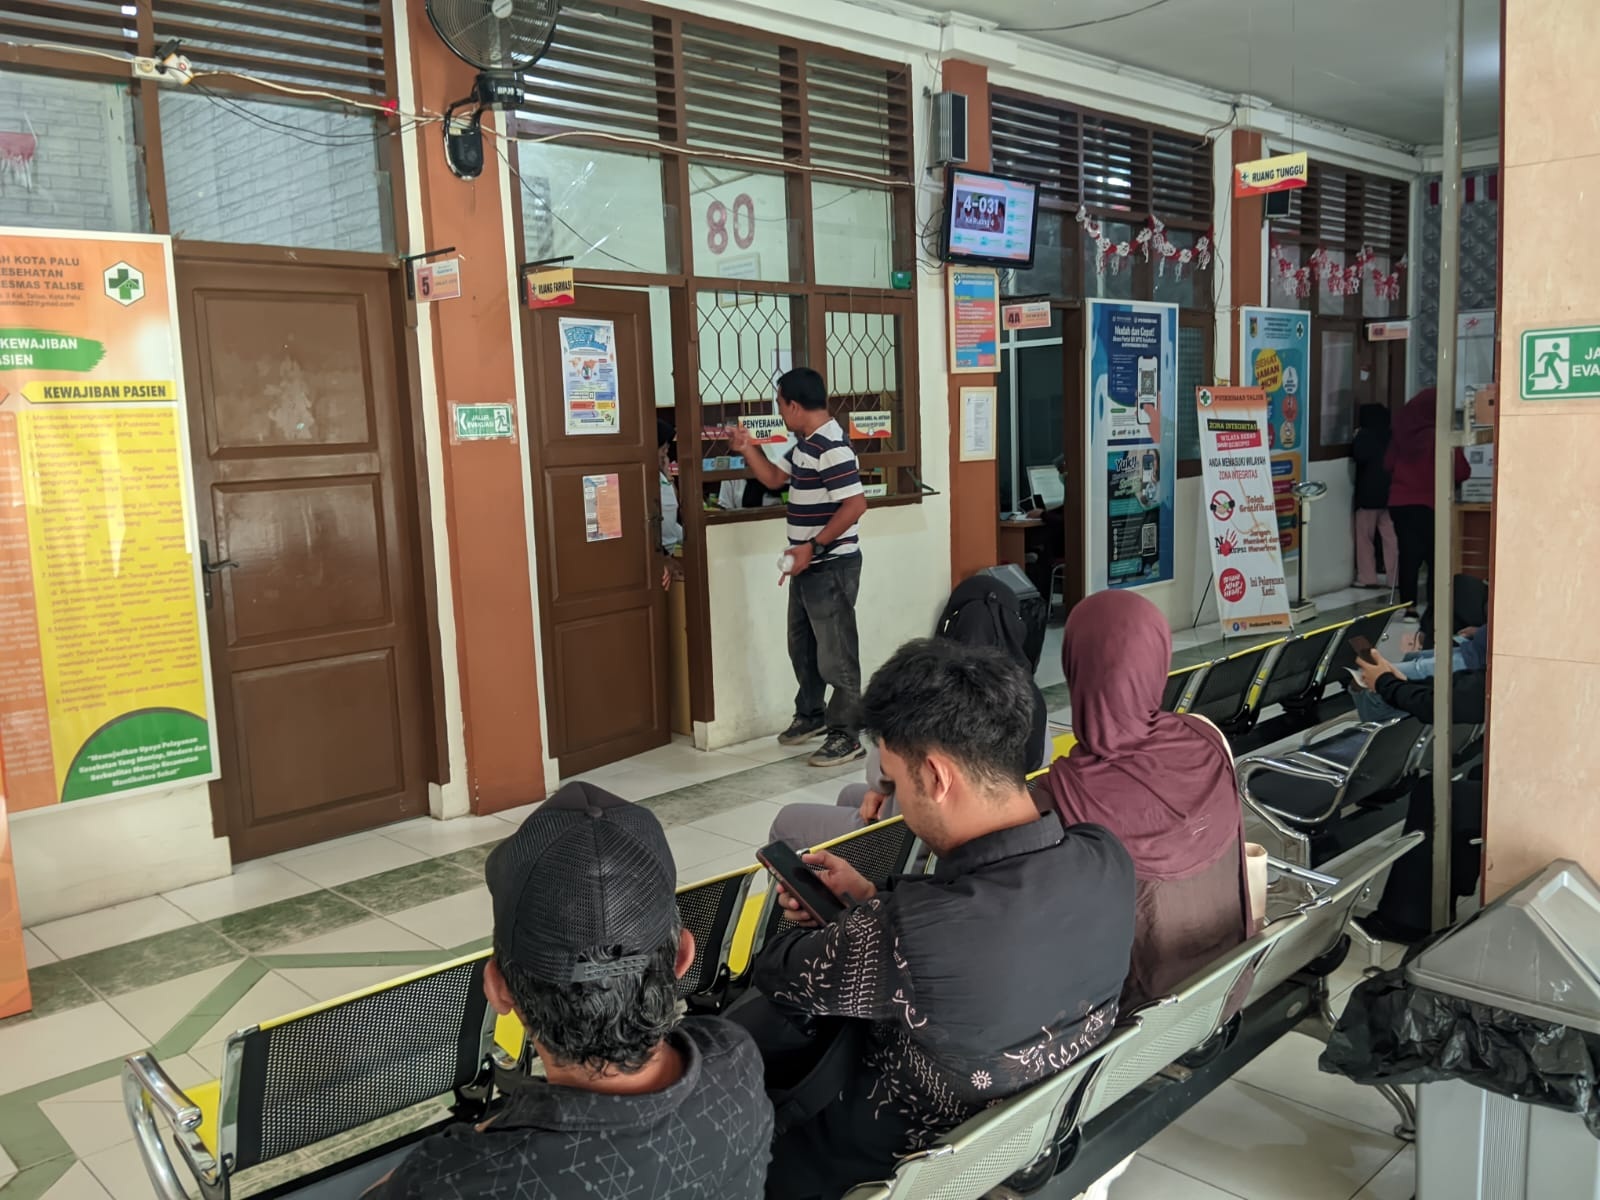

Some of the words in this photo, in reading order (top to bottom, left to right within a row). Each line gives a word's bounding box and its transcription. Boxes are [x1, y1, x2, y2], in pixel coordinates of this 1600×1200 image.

[1252, 170, 1275, 182] RUANG
[1276, 165, 1304, 178] TUNGGU
[963, 195, 999, 215] 4-031
[706, 193, 755, 255] 80
[14, 256, 46, 265] KOTA
[50, 256, 80, 266] PALU
[0, 268, 63, 278] ESEHATAN
[0, 280, 40, 289] ESMAS
[44, 281, 85, 291] TALISE
[422, 276, 430, 296] 5
[0, 338, 78, 350] KEWAJIBAN
[1584, 347, 1600, 360] JA
[1572, 364, 1600, 377] EVA
[43, 385, 120, 399] KEWAJIBAN
[124, 385, 166, 397] PASIEN
[743, 419, 784, 429] PENYERAHAN
[756, 430, 771, 438] OBAT
